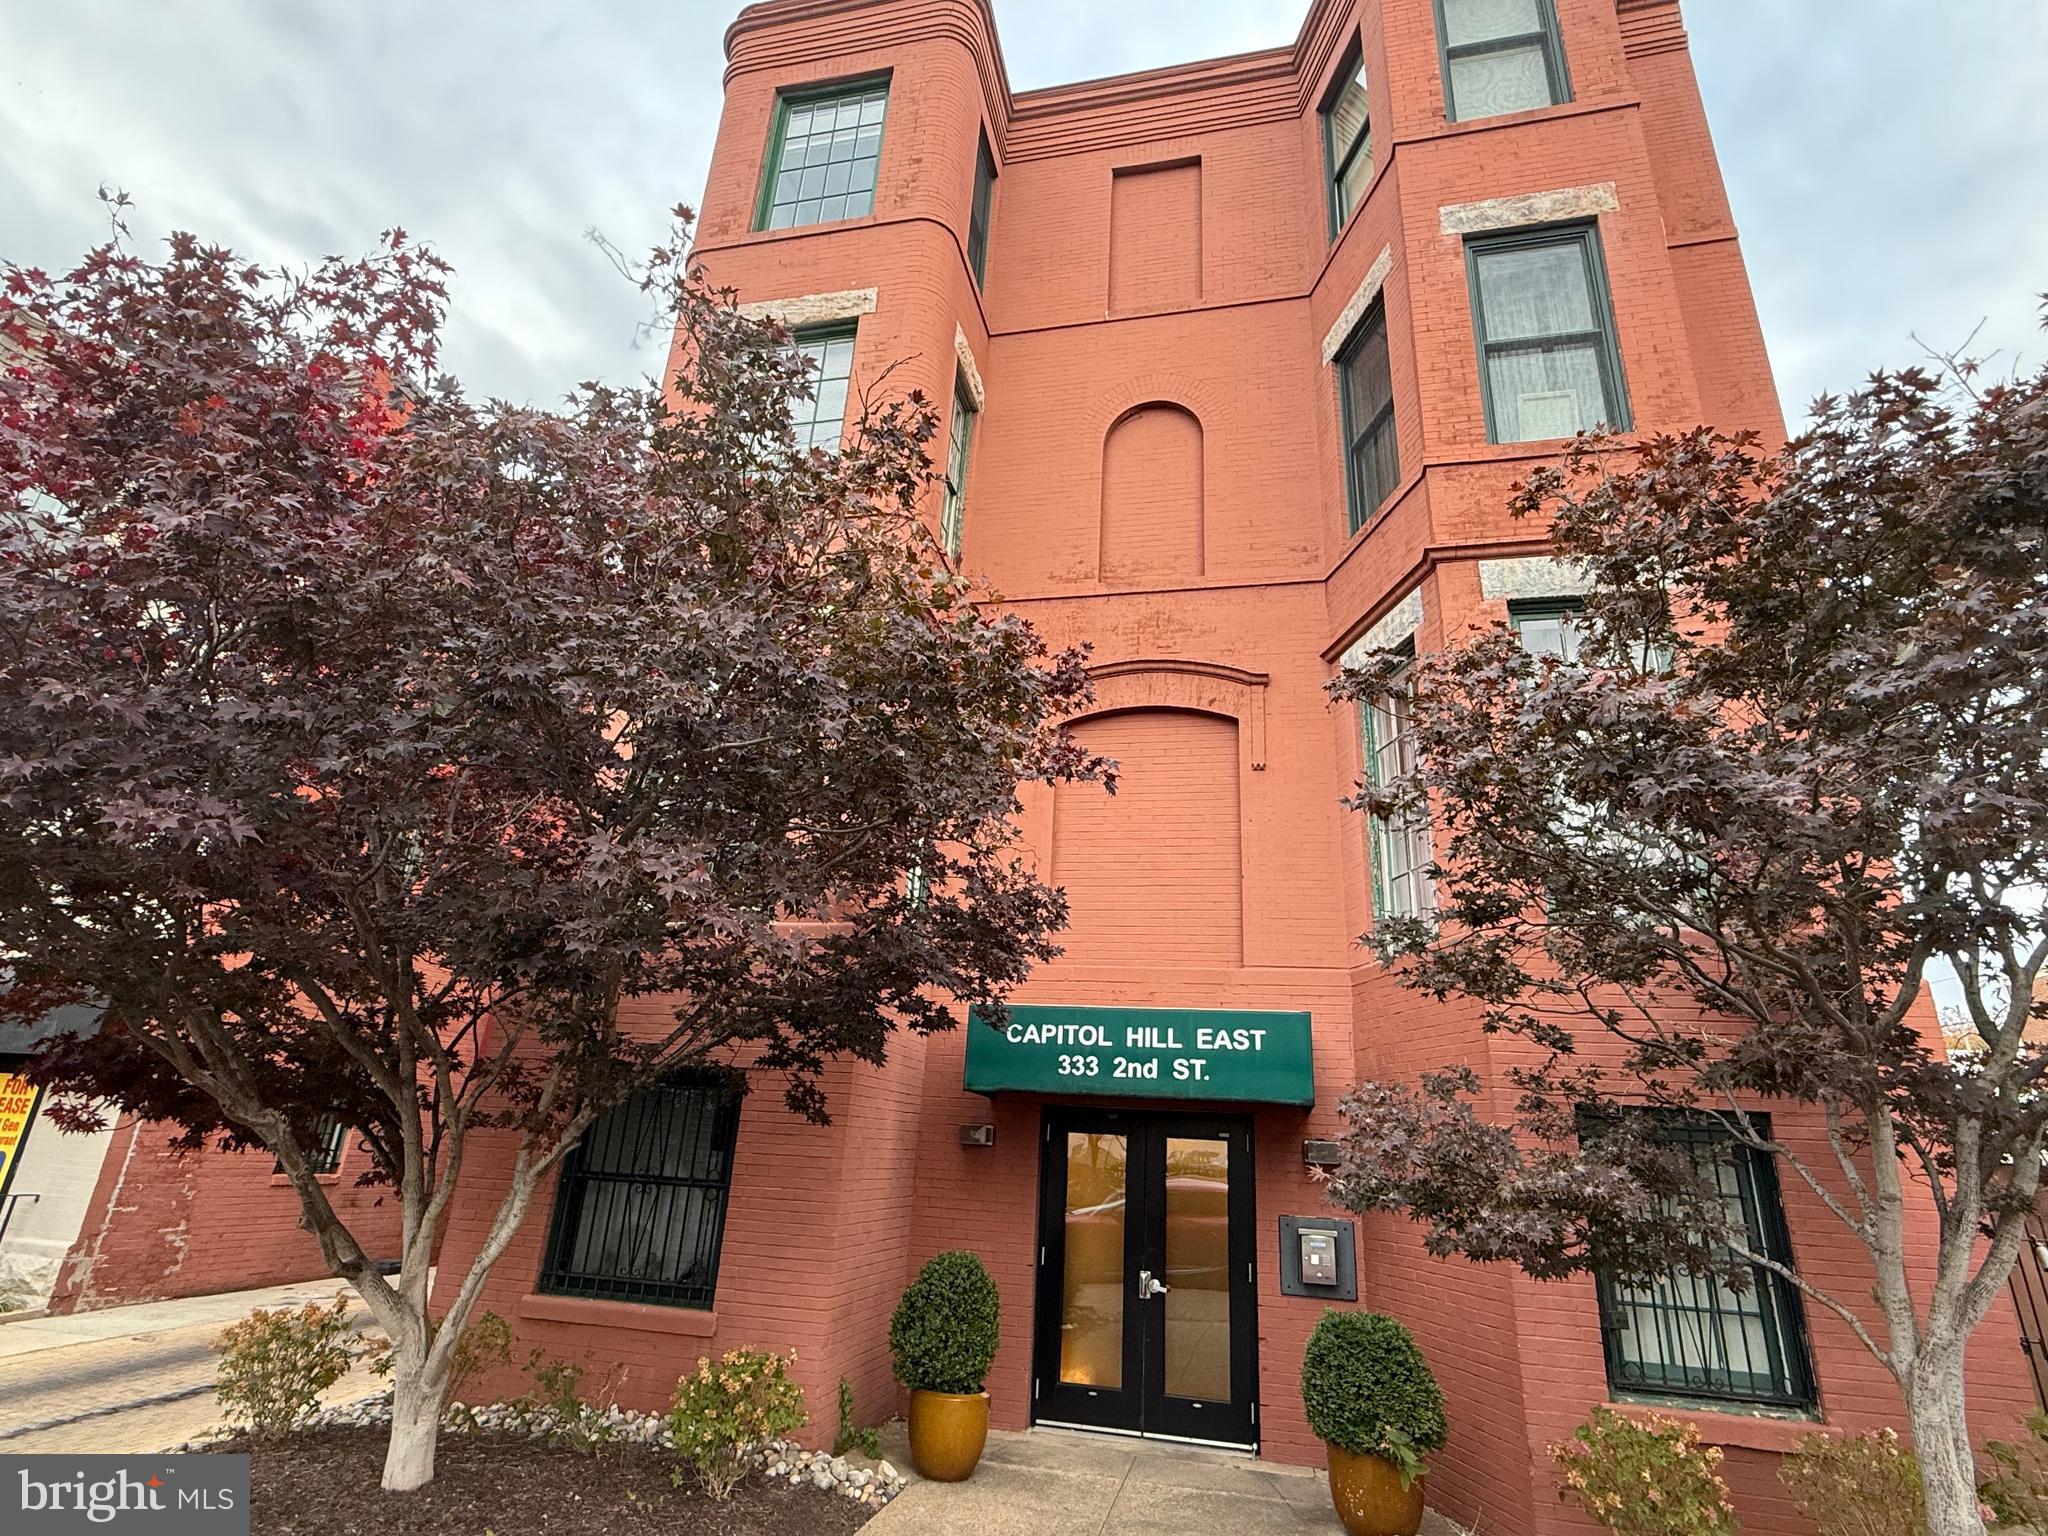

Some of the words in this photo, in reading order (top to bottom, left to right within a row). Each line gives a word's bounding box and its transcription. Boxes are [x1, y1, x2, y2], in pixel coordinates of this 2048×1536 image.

[1006, 1023, 1113, 1047] CAPITOL
[1126, 1026, 1183, 1049] HILL
[1196, 1028, 1267, 1051] EAST
[1057, 1054, 1100, 1077] 333
[1112, 1056, 1158, 1079] 2nd
[1172, 1058, 1210, 1081] ST.
[2, 1077, 29, 1095] FOR
[0, 1097, 31, 1114] EASE
